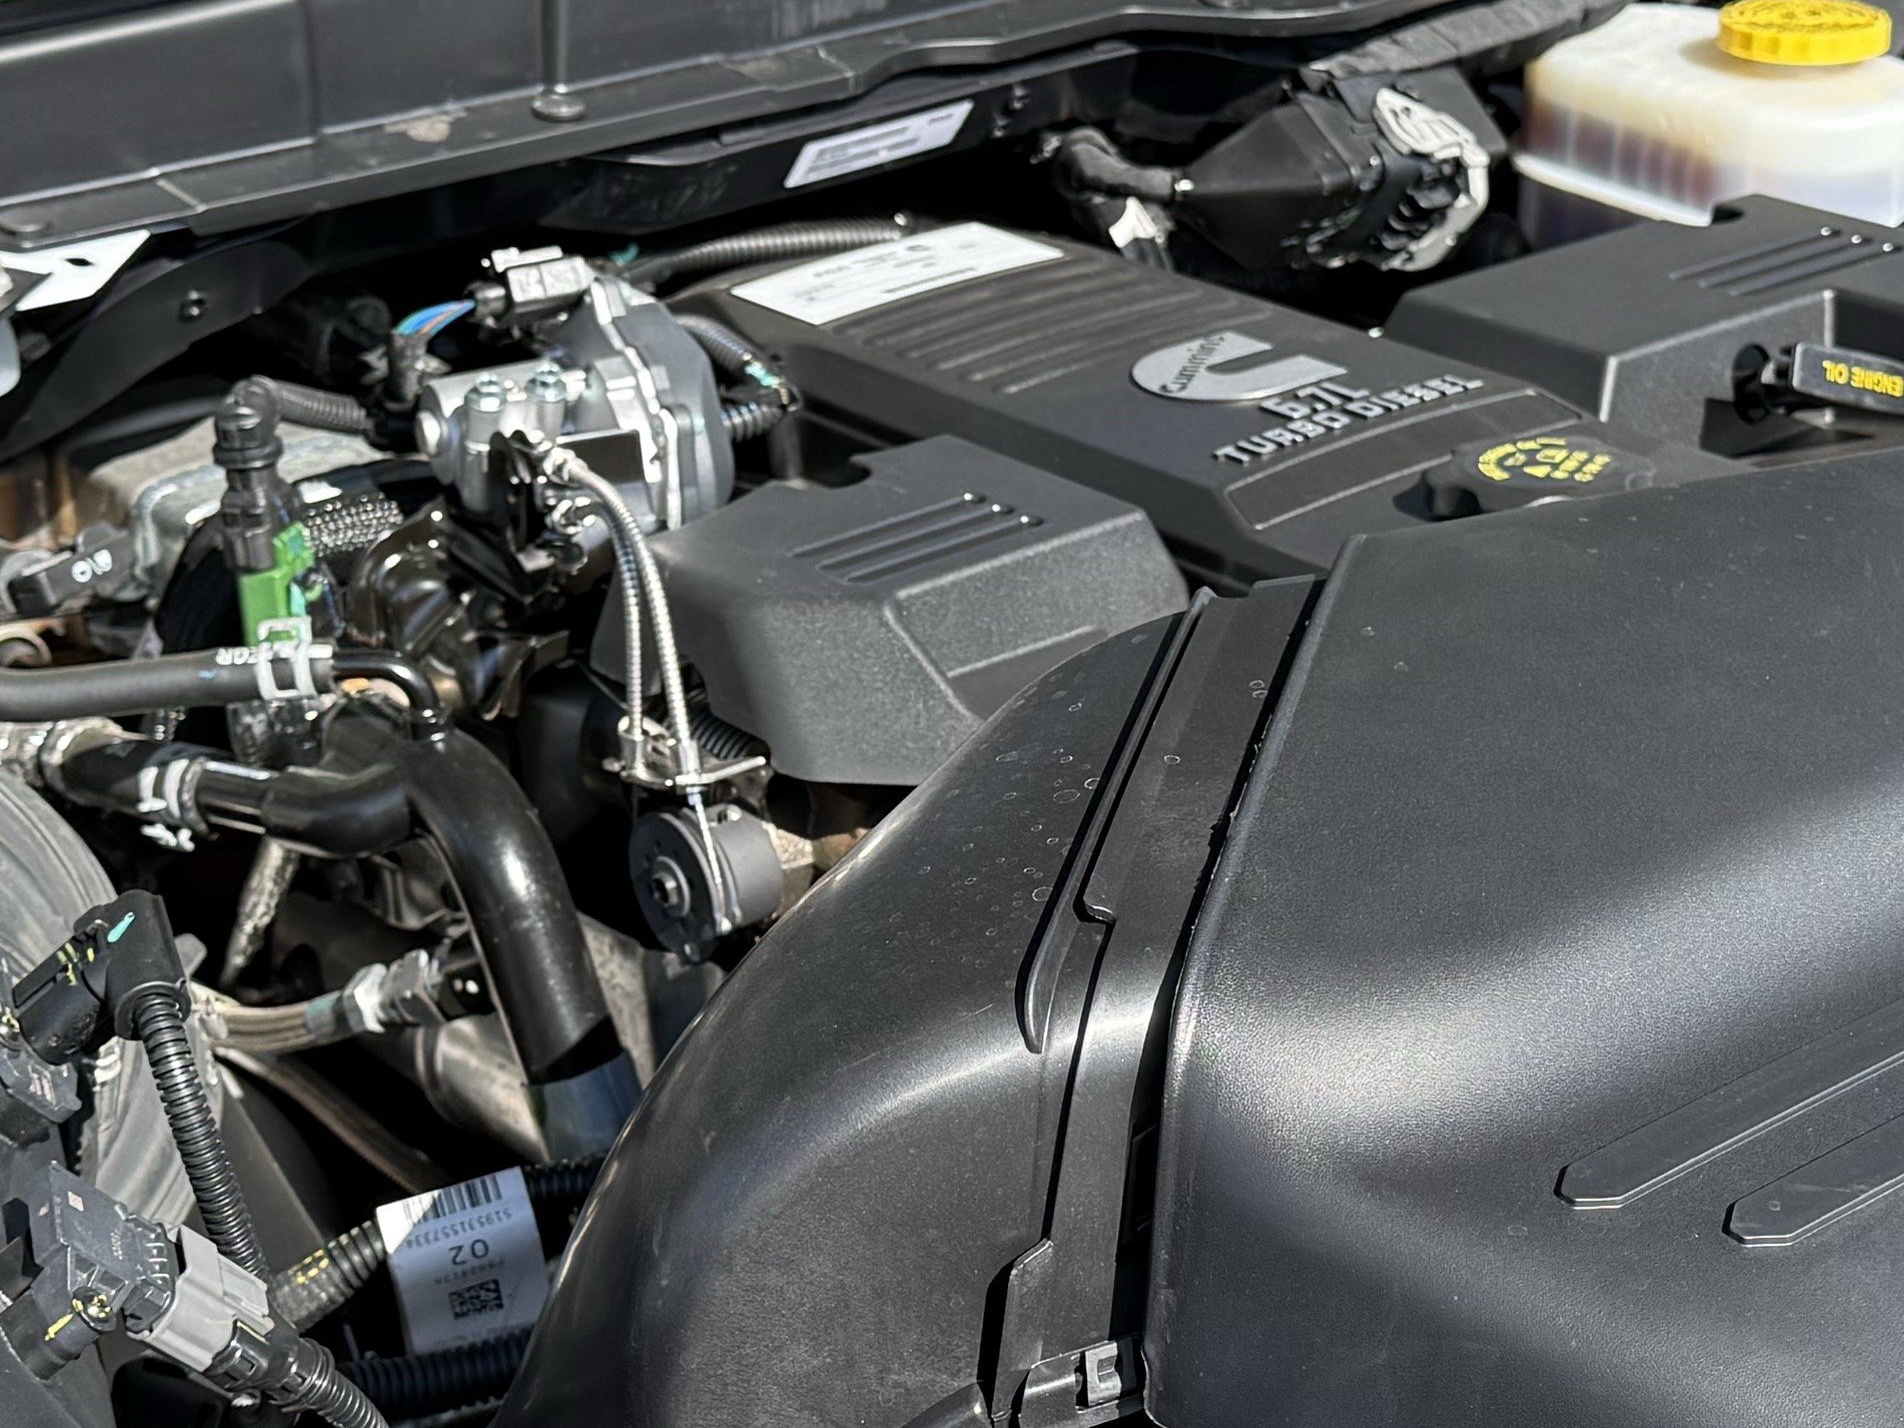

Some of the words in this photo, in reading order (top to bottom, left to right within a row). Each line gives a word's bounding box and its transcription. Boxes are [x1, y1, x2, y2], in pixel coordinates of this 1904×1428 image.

[1822, 360, 1849, 385] OIL
[1260, 381, 1372, 420] 6.7L
[1211, 410, 1350, 467] TURBO
[1346, 373, 1485, 420] DIESEL
[448, 1238, 489, 1265] 02
